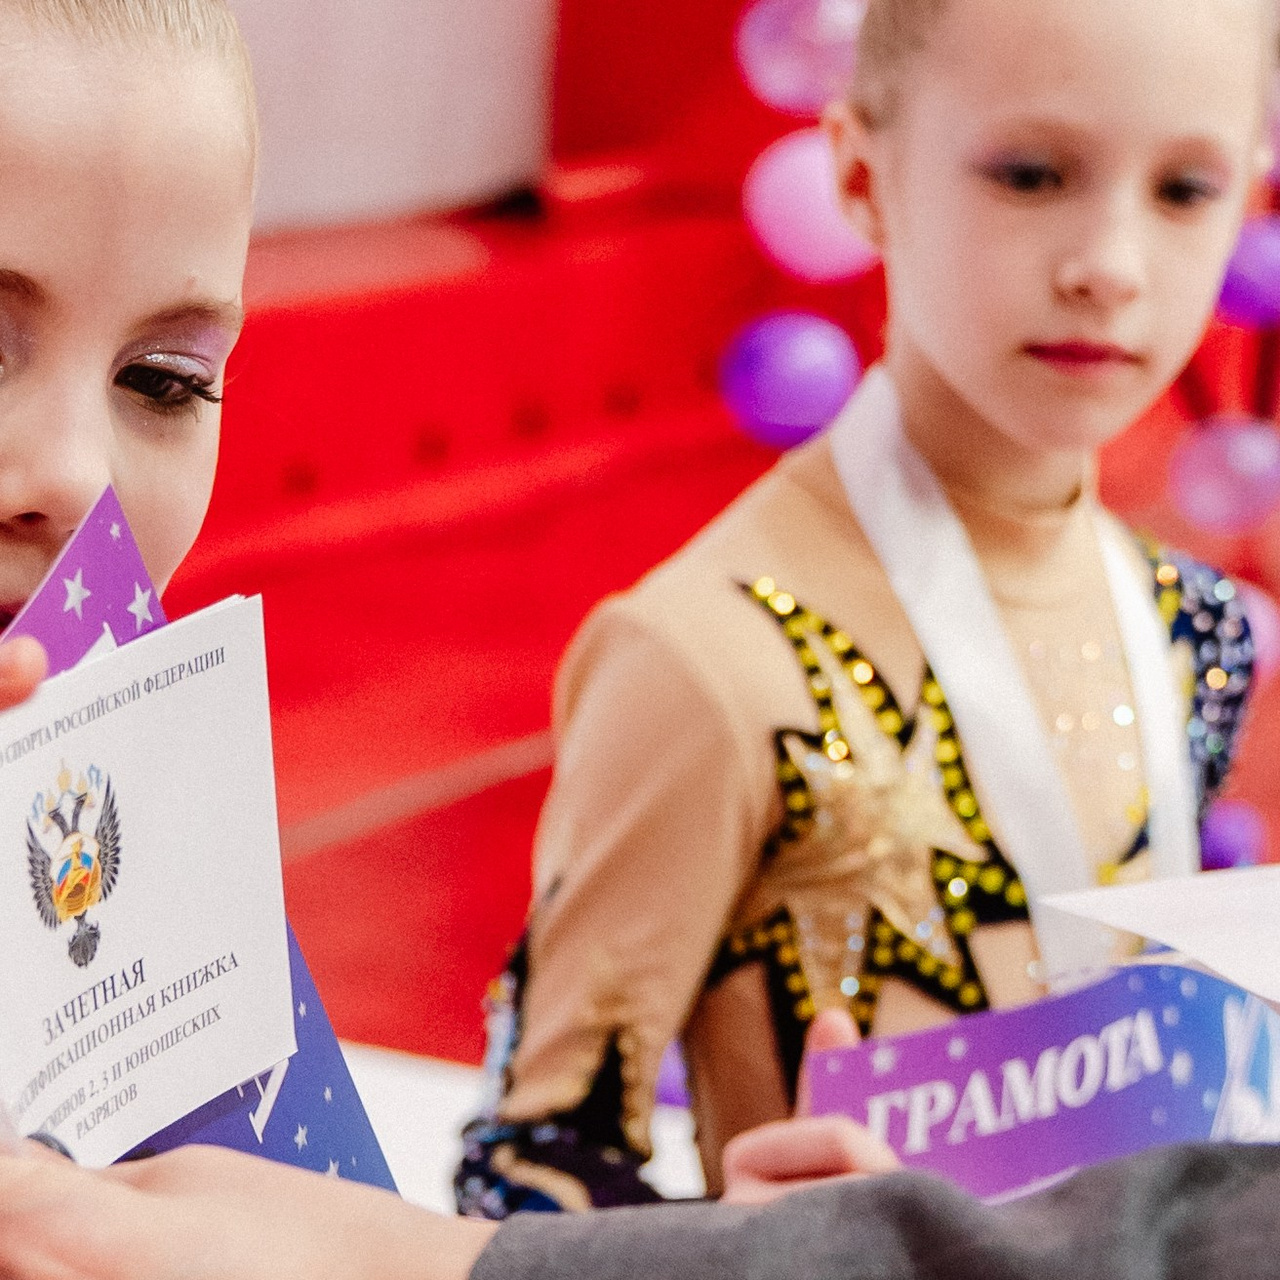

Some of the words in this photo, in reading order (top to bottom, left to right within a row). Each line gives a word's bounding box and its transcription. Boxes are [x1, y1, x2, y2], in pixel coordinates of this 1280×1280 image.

[54, 679, 142, 739] РОССИЙСКОЙ
[142, 646, 226, 695] ФЕДЕРАЦИИ
[42, 957, 147, 1047] ЗАЧЕТНАЯ
[160, 951, 239, 1009] КНИЖКА
[103, 1070, 109, 1091] 3
[125, 1003, 223, 1073] ЮНОШЕСКИХ
[865, 1007, 1164, 1156] ГРАМОТА
[75, 1082, 139, 1141] РАЗРЯДОВ
